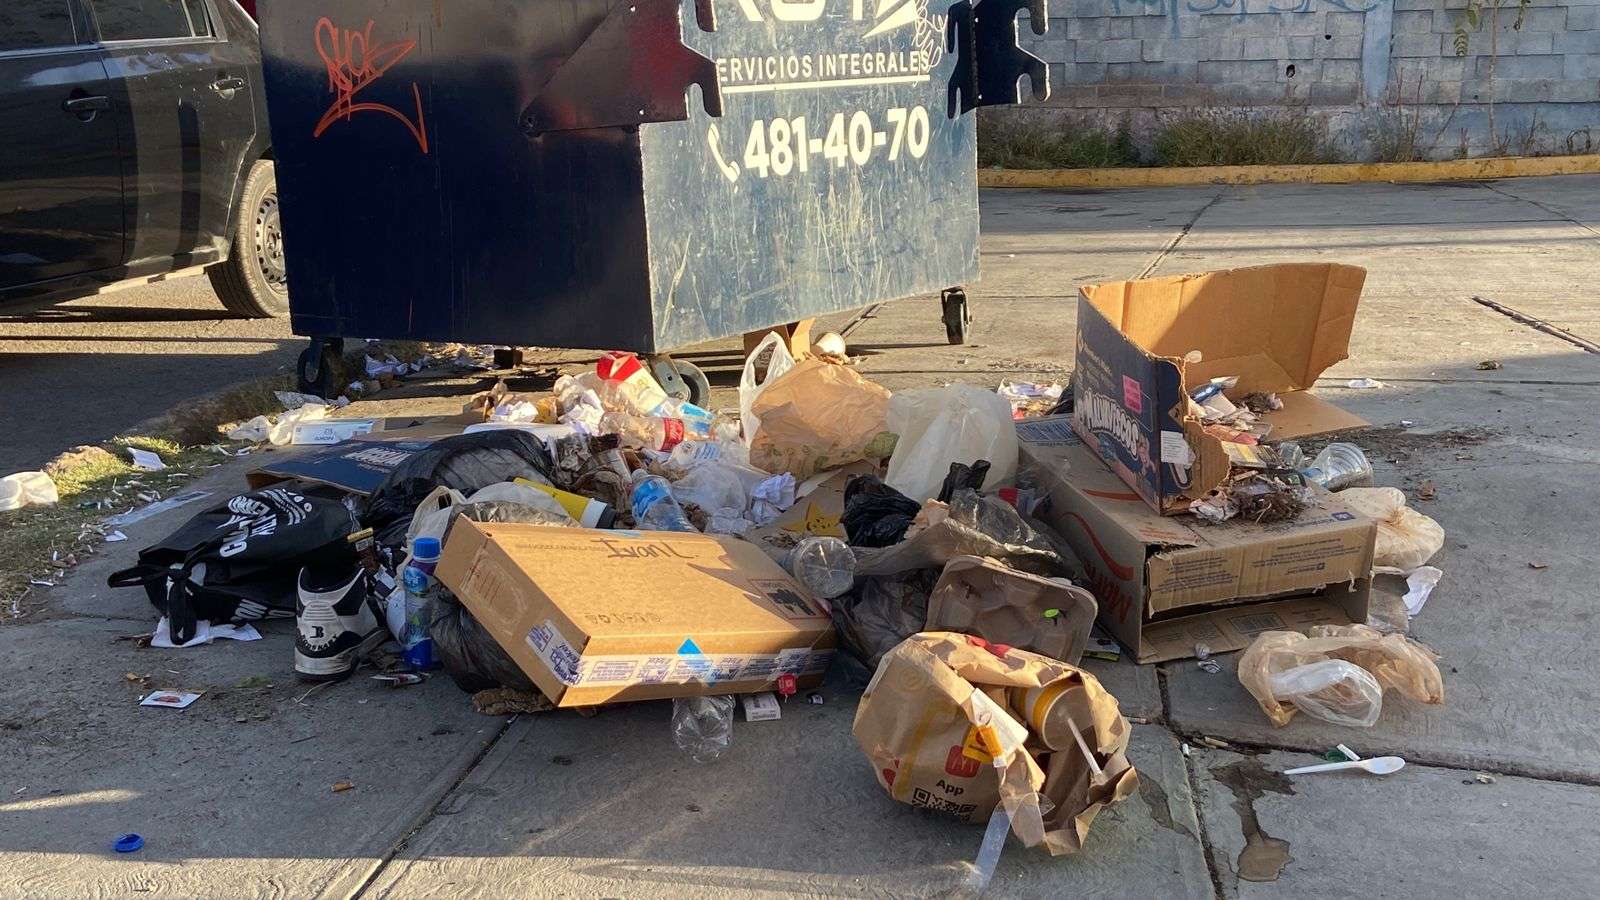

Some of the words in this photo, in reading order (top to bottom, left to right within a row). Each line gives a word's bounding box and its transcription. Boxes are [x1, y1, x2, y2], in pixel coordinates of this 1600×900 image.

[716, 55, 812, 82] ERVICIOS
[818, 50, 930, 77] INTEGRALES
[743, 105, 930, 179] 481-40-70
[935, 779, 964, 796] App
